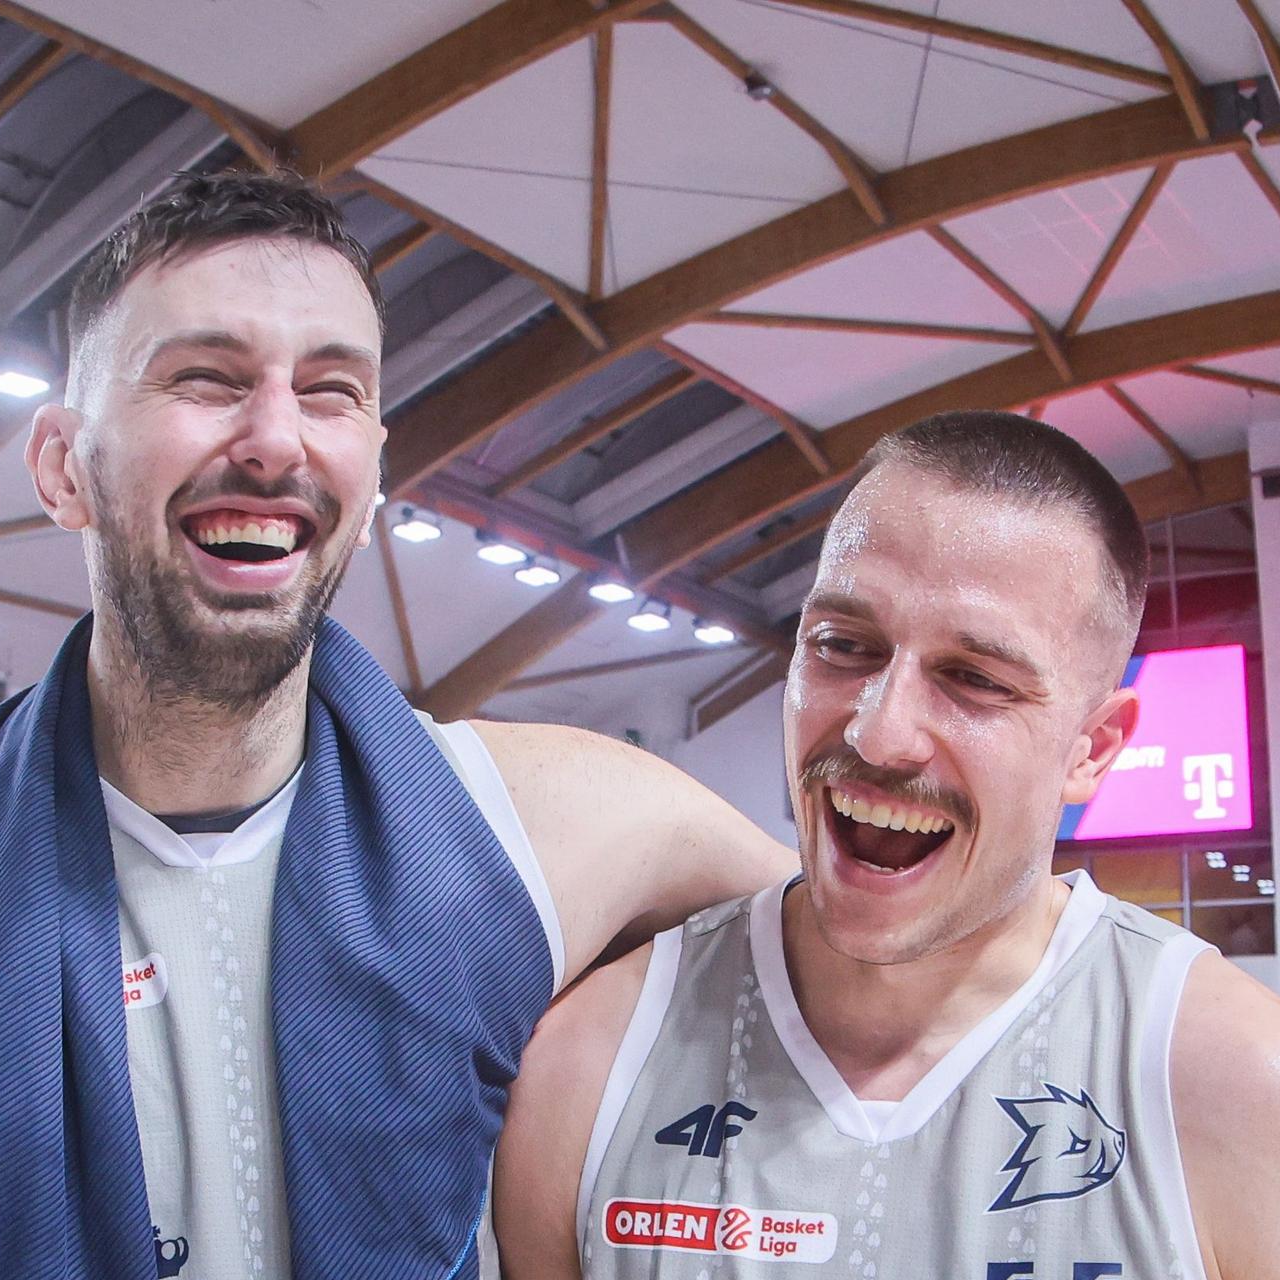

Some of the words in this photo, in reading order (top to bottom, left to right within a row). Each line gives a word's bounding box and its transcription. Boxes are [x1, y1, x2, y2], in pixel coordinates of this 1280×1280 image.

[655, 1101, 758, 1157] 4F
[615, 1210, 708, 1241] ORLEN
[761, 1217, 824, 1236] Basket
[759, 1236, 797, 1257] Liga
